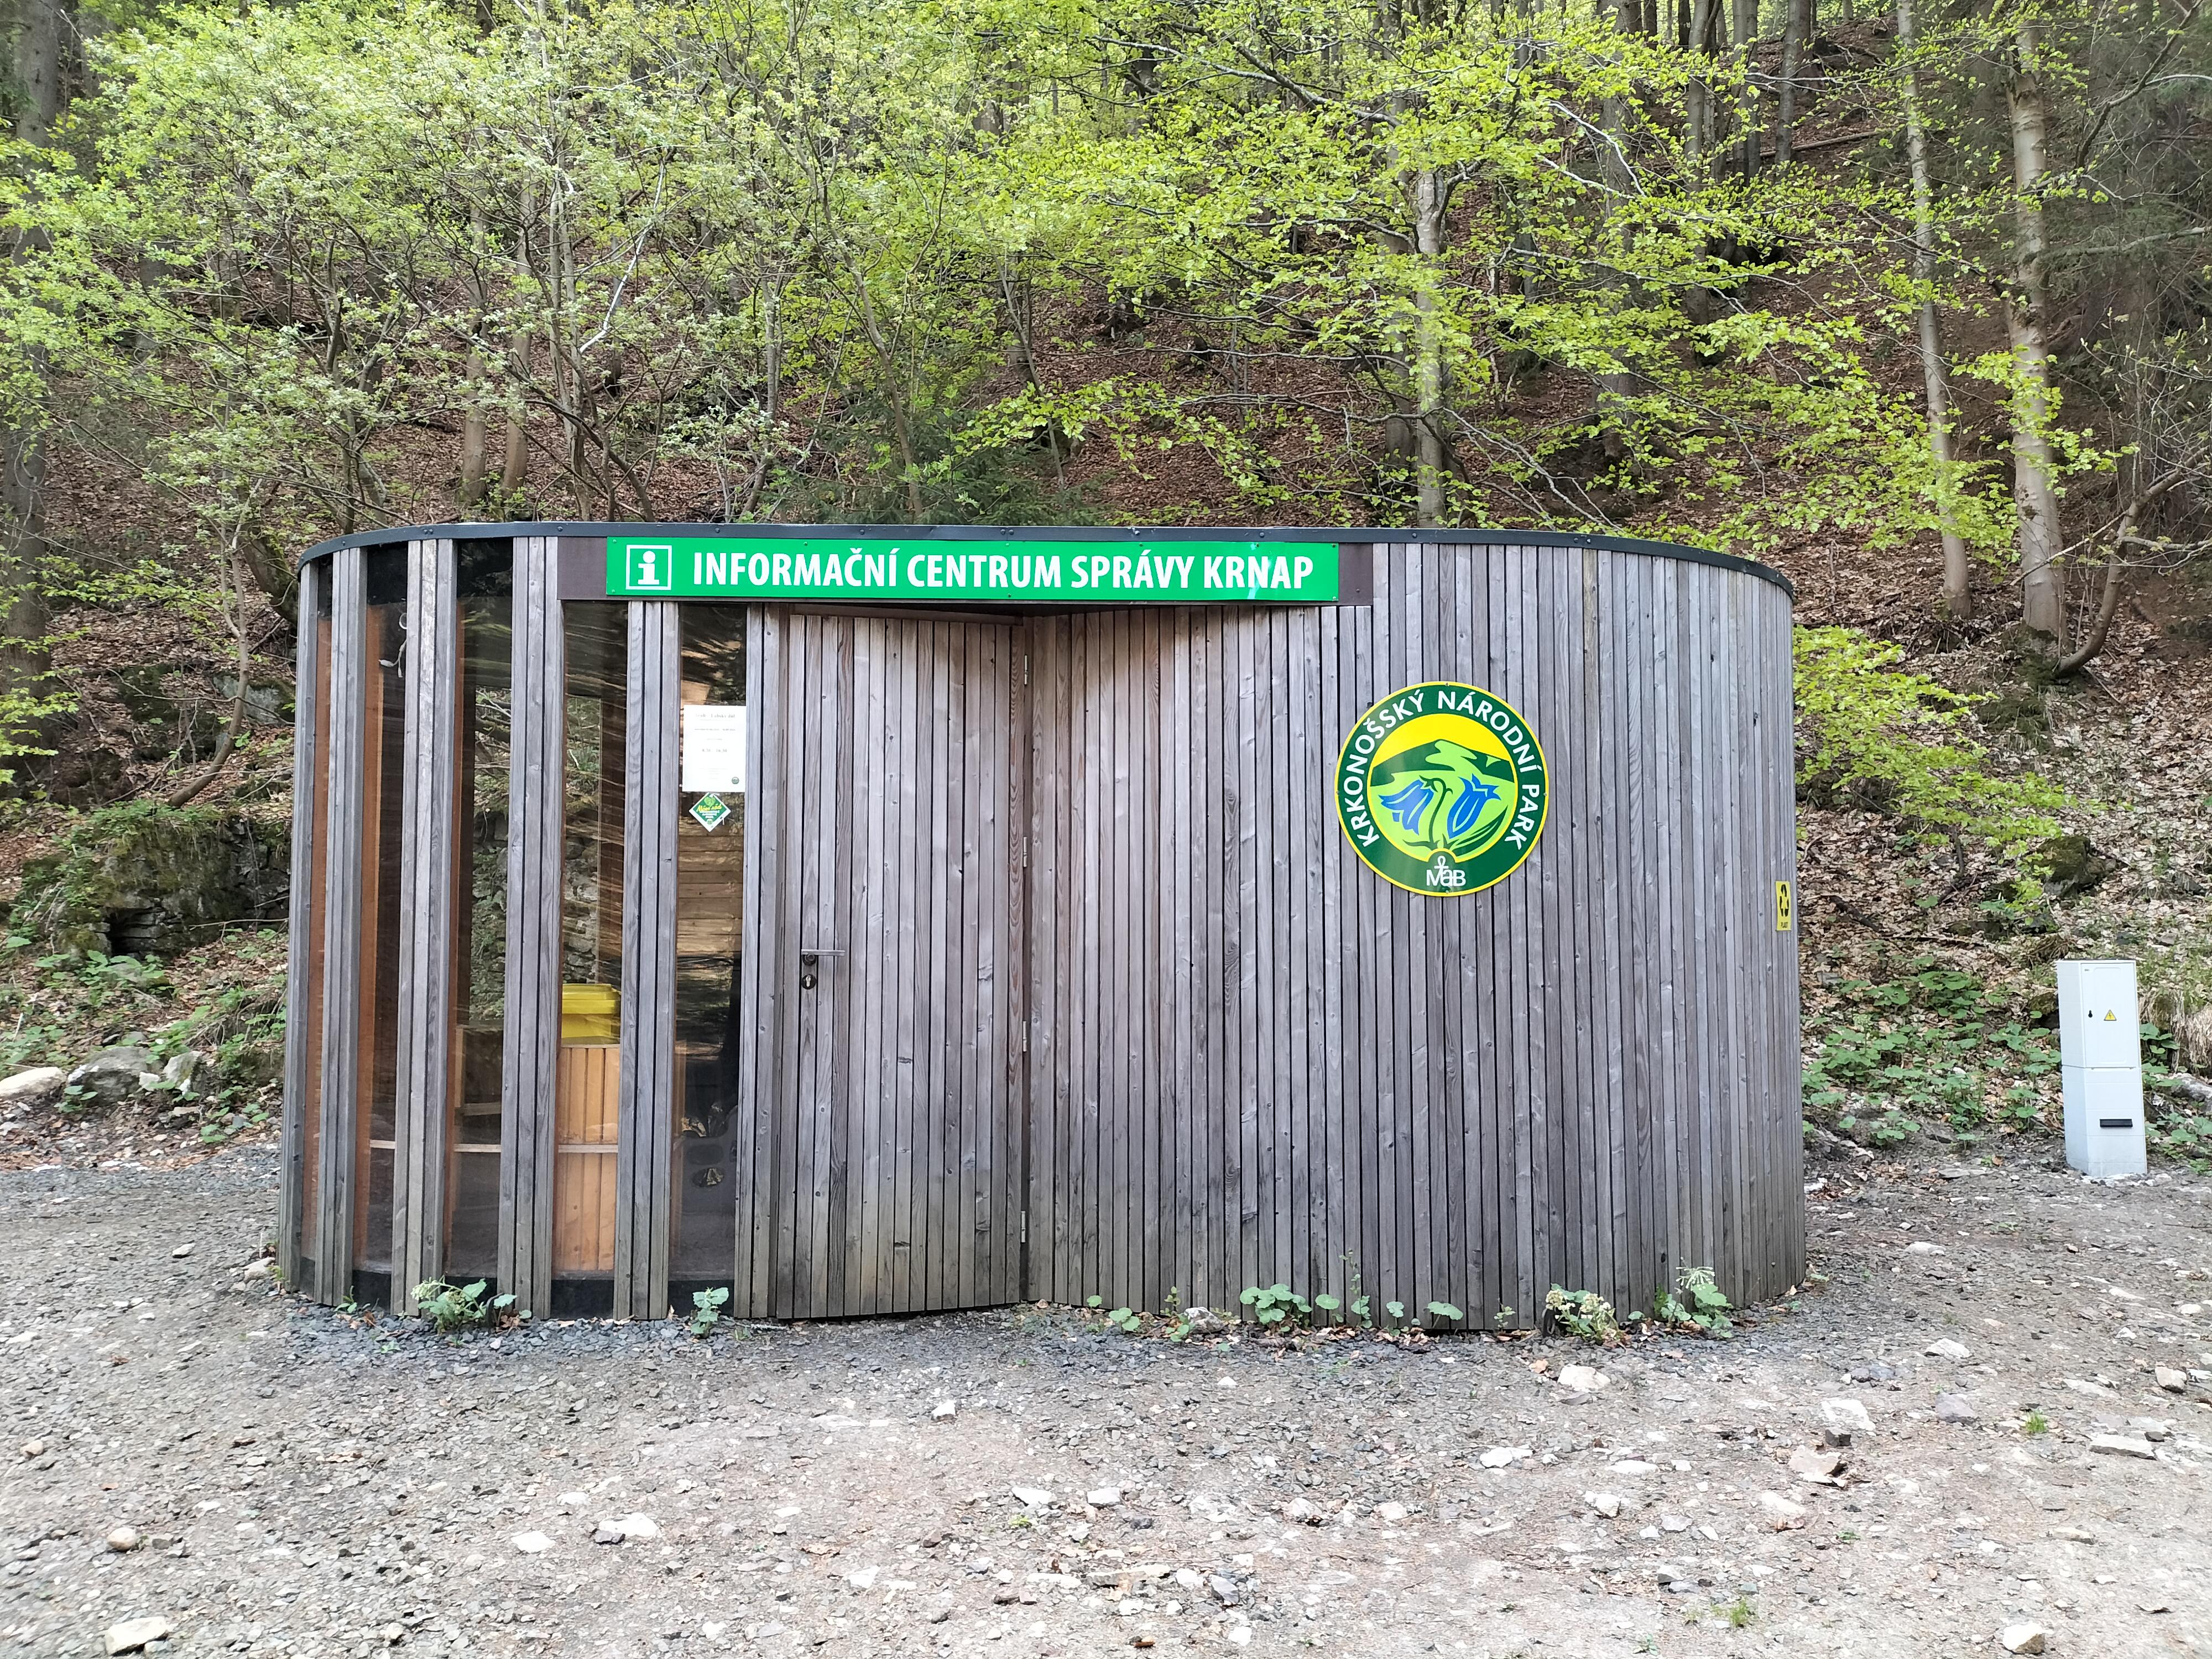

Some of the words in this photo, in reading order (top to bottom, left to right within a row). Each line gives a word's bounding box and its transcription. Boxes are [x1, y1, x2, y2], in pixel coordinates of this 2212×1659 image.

[694, 548, 900, 587] INFORMAČNÍ
[907, 555, 1061, 588] CENTRUM
[1071, 550, 1195, 588] SPRÁVY
[1204, 556, 1313, 589] KRNAP
[1344, 689, 1424, 847] KRKONOŠSKÝ
[1438, 691, 1542, 773] NÁRODNÍ
[1504, 784, 1540, 850] PARK
